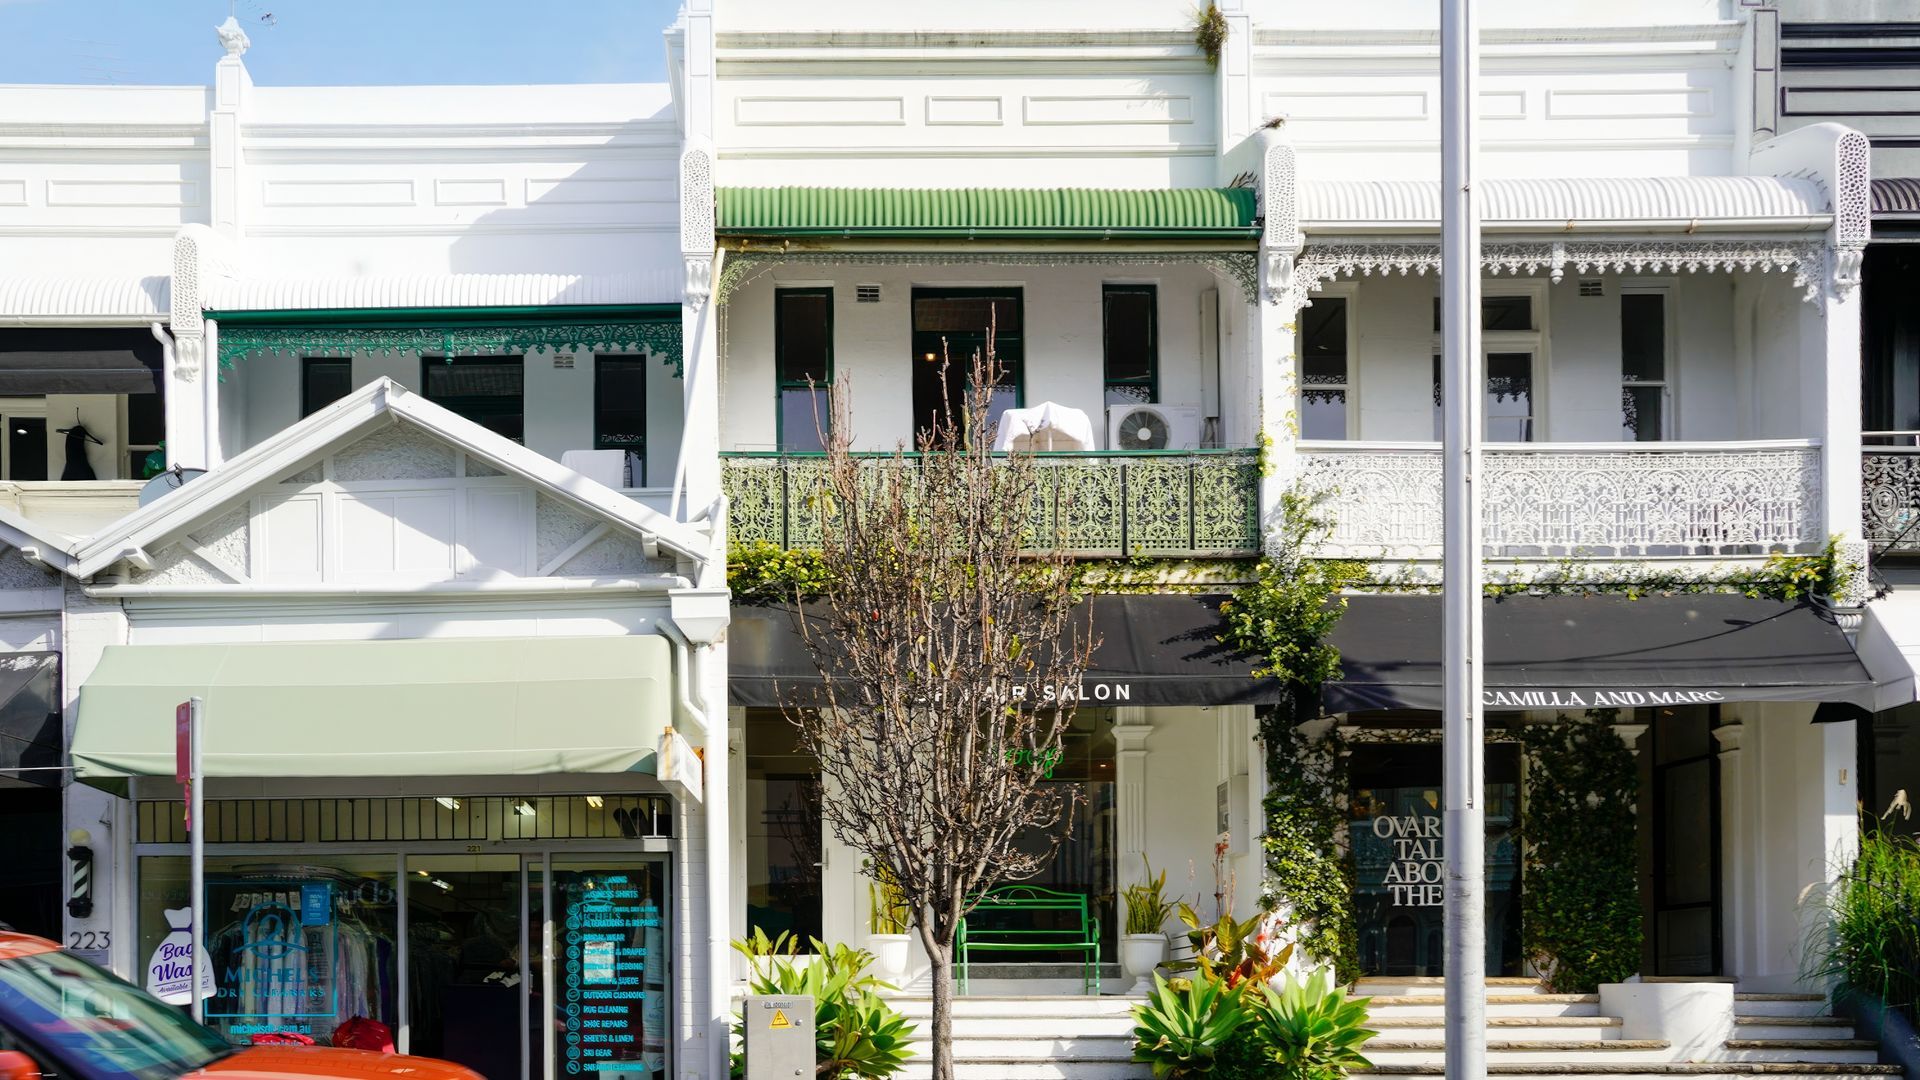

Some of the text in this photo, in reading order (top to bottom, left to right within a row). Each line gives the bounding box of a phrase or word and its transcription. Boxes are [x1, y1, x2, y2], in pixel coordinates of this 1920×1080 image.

[1043, 684, 1131, 701] SALON
[1482, 691, 1725, 706] CAMILLA AND MARC
[1373, 815, 1444, 838] OVAR
[1393, 839, 1445, 860] TAL
[1383, 861, 1445, 884] ABO
[615, 890, 639, 899] SHIRTS
[1387, 884, 1445, 907] THE
[583, 919, 659, 927] ALTERATIONS & REPAIRS
[70, 931, 111, 950] 223
[606, 934, 625, 942] WEAR
[615, 948, 621, 956] &
[622, 948, 648, 956] DRAPES
[152, 962, 192, 982] Was
[618, 977, 639, 985] SUEDE
[158, 983, 189, 993] Available
[583, 991, 647, 999] OUTDOOR CUSHIONS
[583, 1006, 629, 1014] RUG CLEANING
[583, 1020, 628, 1028] SHOE REPAIRS
[583, 1049, 613, 1057] SKI GEAR
